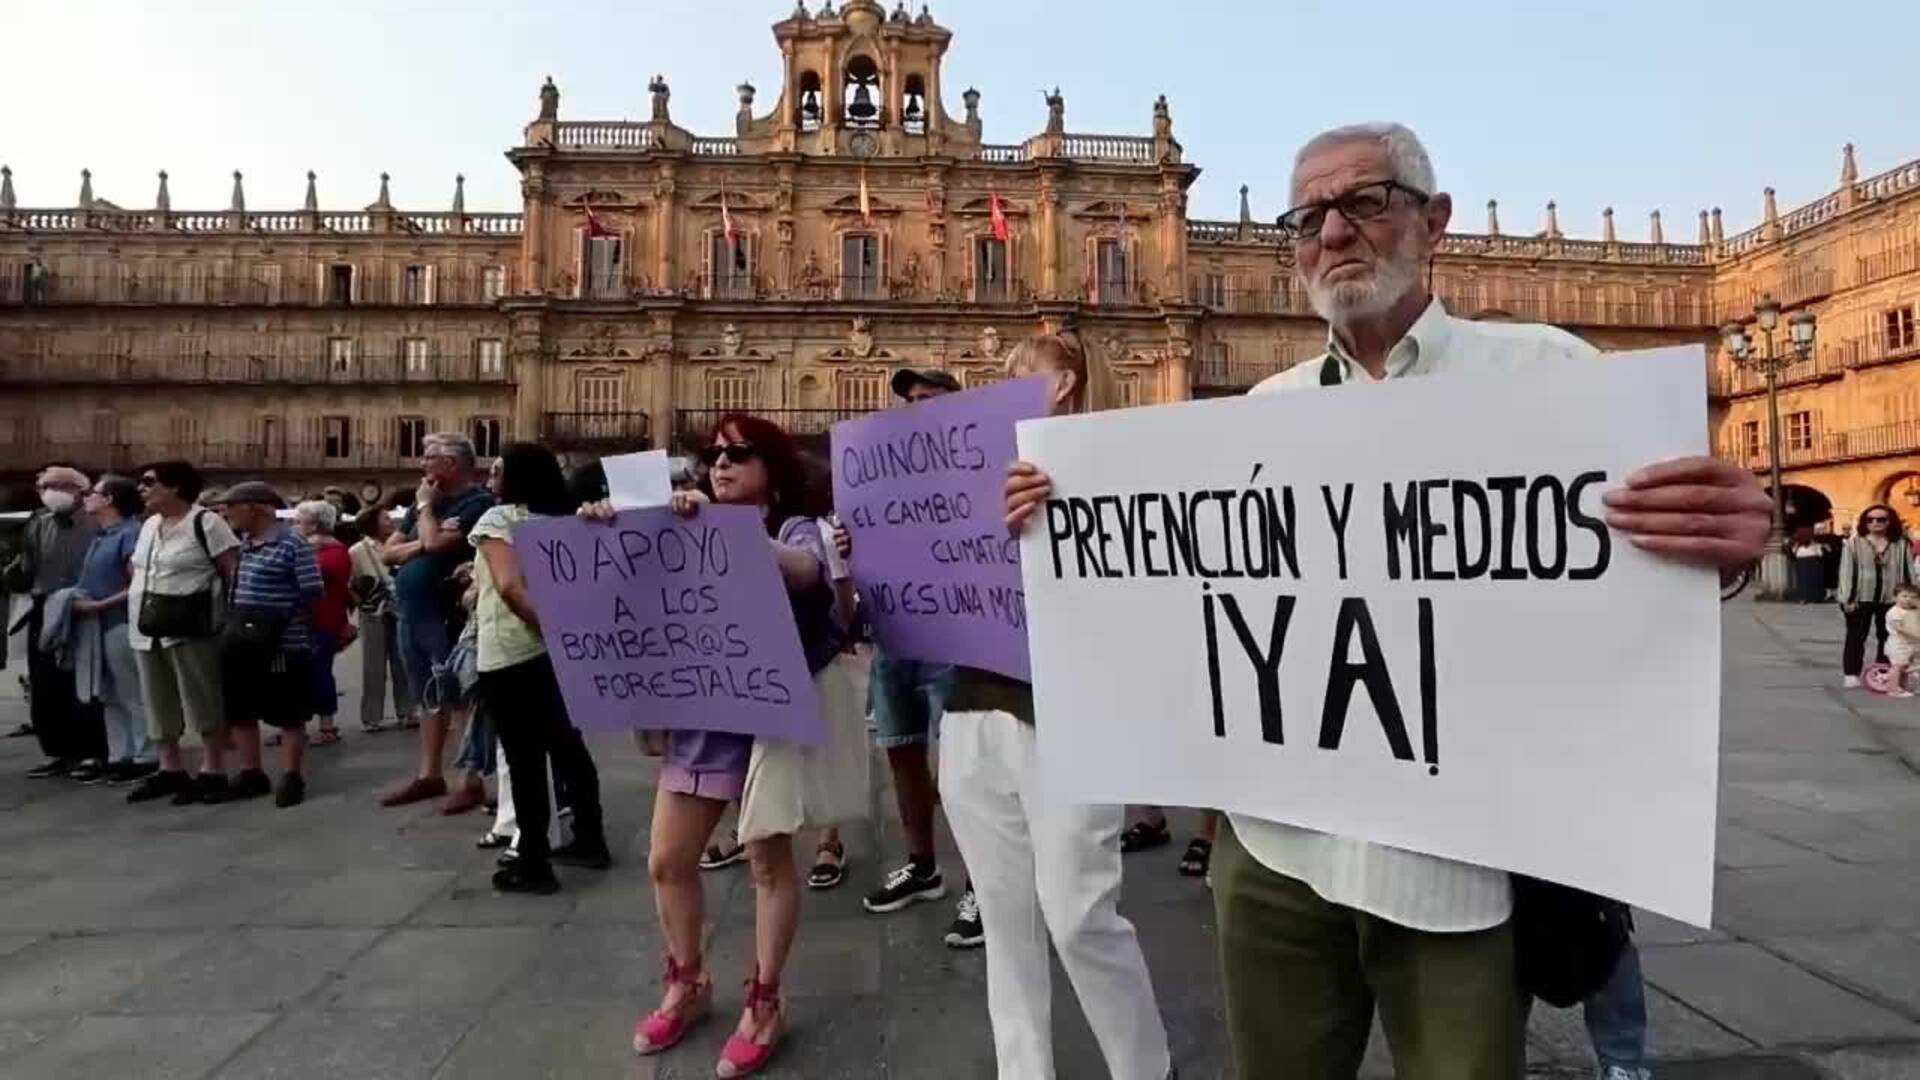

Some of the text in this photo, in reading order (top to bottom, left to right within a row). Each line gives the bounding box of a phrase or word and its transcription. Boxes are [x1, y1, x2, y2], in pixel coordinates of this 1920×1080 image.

[852, 492, 972, 528] EL CAMBIO
[1047, 463, 1612, 580] PREVENCIÓN Y MEDIOS
[538, 527, 729, 583] YO APOYO
[931, 534, 1020, 564] CLIMATIC
[614, 585, 719, 624] A LOS
[901, 581, 939, 614] ES
[943, 583, 985, 617] UNA
[561, 623, 749, 660] BOMBER@S
[594, 665, 791, 704] FORESTALES
[1203, 581, 1439, 776] ¡YA!
